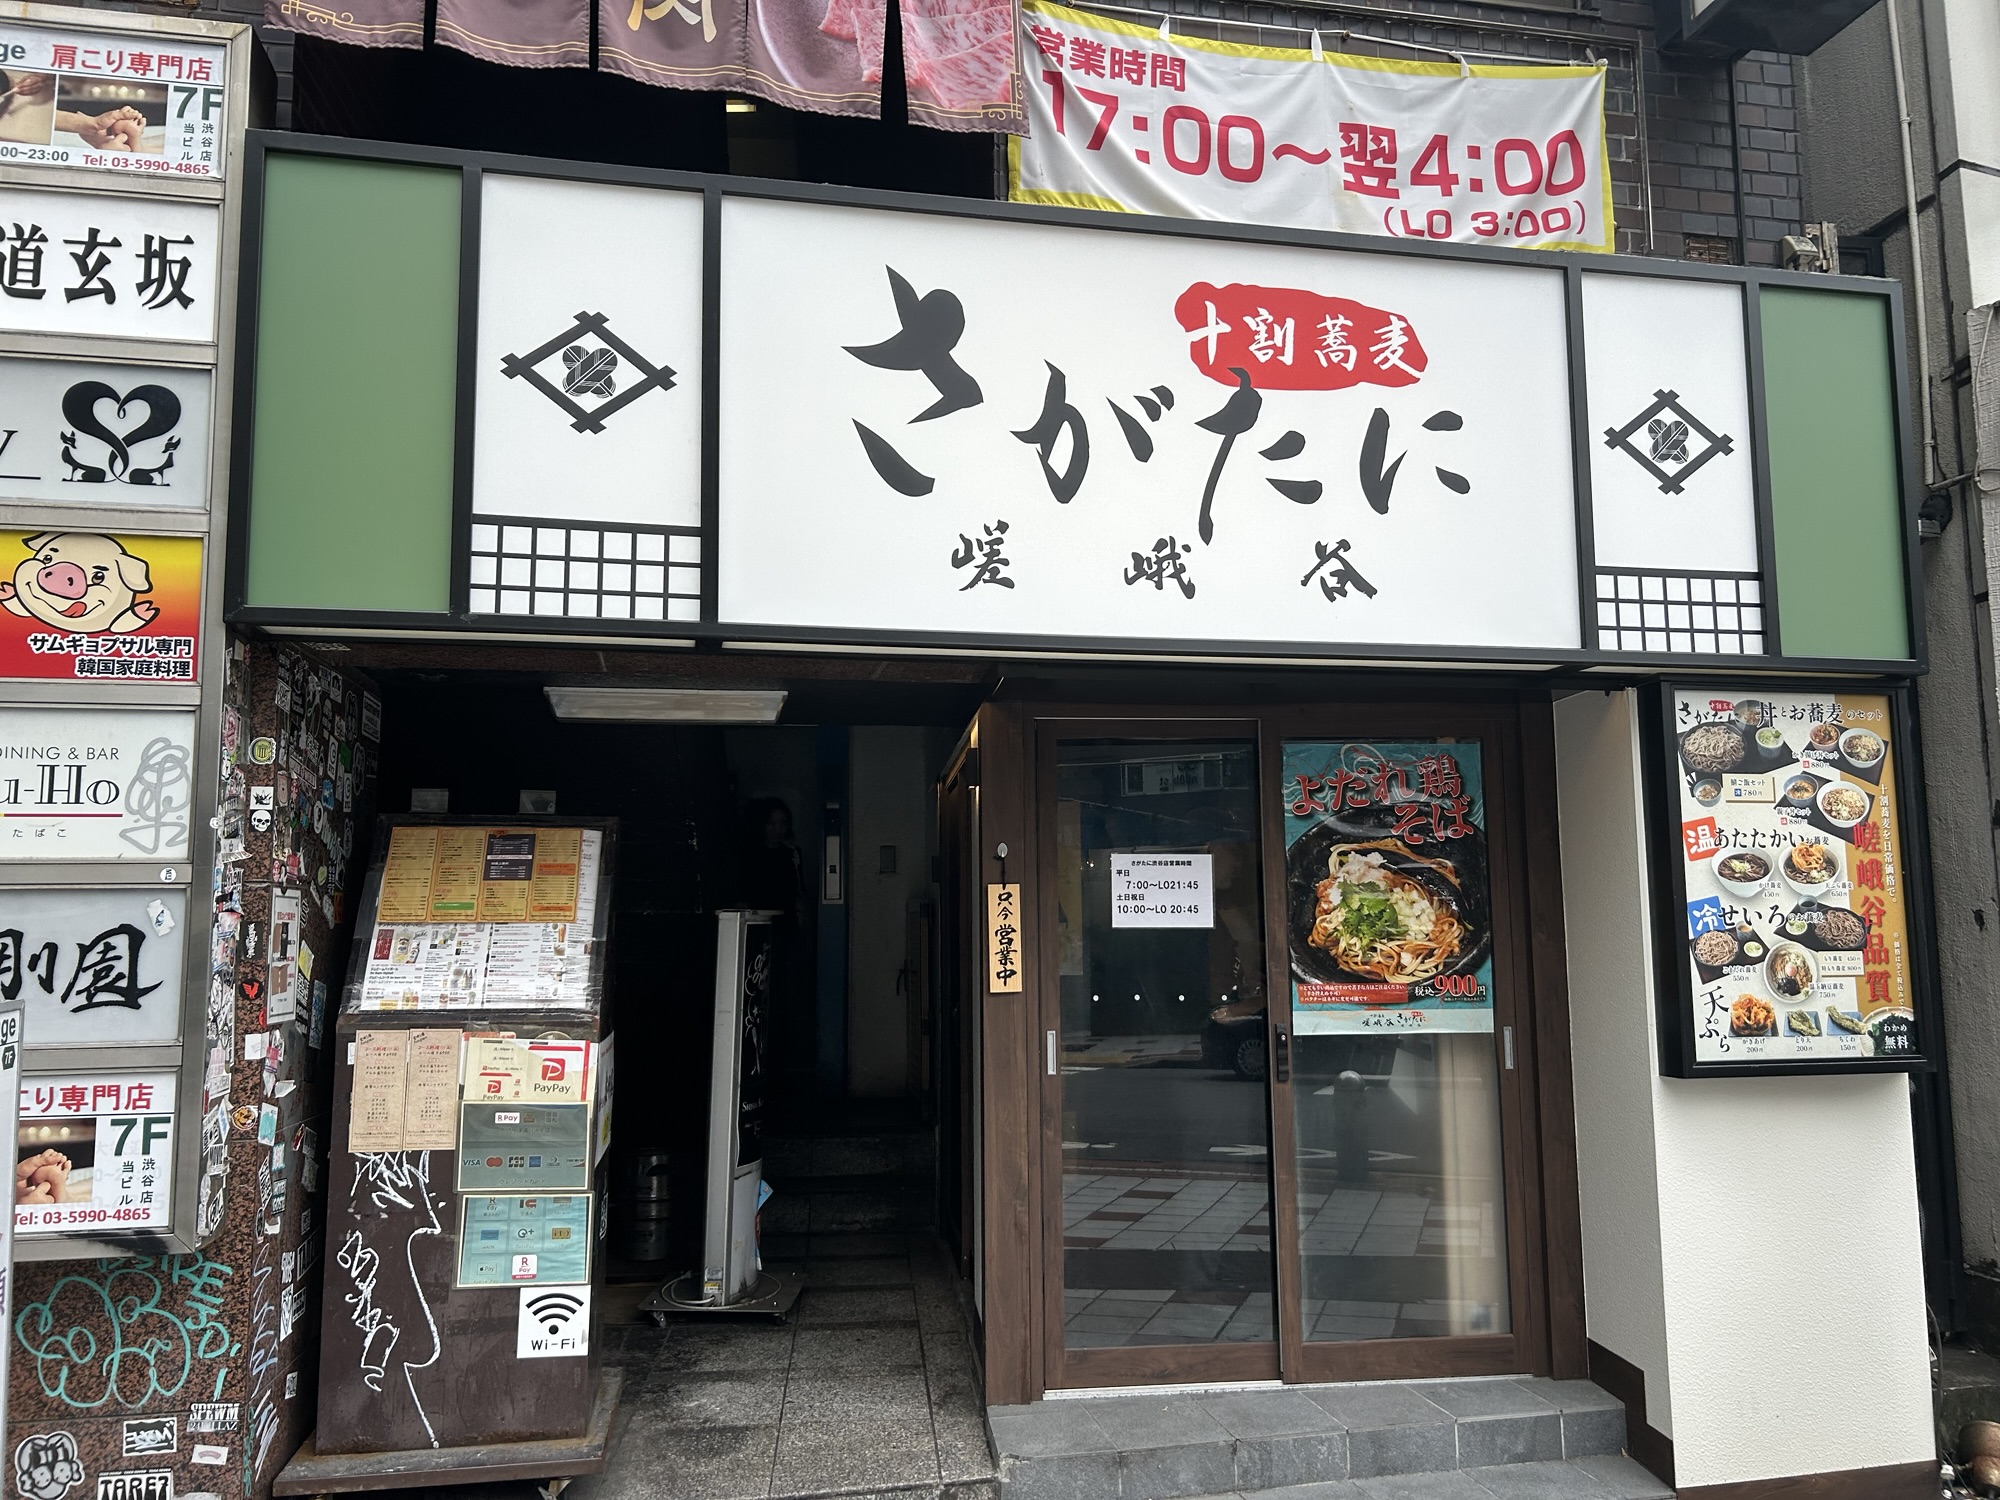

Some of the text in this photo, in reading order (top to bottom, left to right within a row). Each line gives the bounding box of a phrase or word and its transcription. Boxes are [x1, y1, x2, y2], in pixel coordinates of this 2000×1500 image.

[51, 44, 213, 81] 肩こり専門店
[1031, 23, 1187, 92] 営業時間
[173, 86, 223, 121] 7F
[182, 123, 195, 162] 当ビル
[200, 122, 214, 162] 渋谷店
[83, 154, 210, 175] Tel: 03-5990-4865
[0, 223, 195, 310] 道玄坂
[1190, 299, 1425, 383] 十割蕎麦
[840, 263, 1472, 546] さがたに
[950, 518, 1379, 602] 嵯峨谷
[28, 633, 193, 656] サムギョプサル専門
[76, 657, 192, 678] 韓国家庭料理
[1678, 701, 1739, 725] さがたに
[1756, 702, 1883, 728] 丼とお蕎麦のセット
[67, 747, 79, 760] &
[87, 747, 119, 760] BAR
[1811, 761, 1830, 769] 880円
[1291, 754, 1462, 816] よだれ鶏
[12, 828, 67, 838] たばこ
[1392, 795, 1475, 844] そば
[1686, 824, 1830, 854] 温 あたたかいお蕎麦
[1879, 784, 1898, 903] 十割蕎麦を日常価格で。
[1116, 869, 1130, 877] 平日
[1116, 893, 1145, 901] 土日祝日
[1170, 904, 1199, 914] 20:45
[1692, 903, 1825, 932] 冷 せいろのお蕎麦
[1853, 822, 1893, 1003] 嵯峨谷品質
[994, 891, 1018, 987] 只今営業中
[1, 1016, 16, 1042] ge
[1699, 985, 1731, 1053] 天ぷら
[1883, 1024, 1908, 1032] わかめ
[1884, 1035, 1909, 1049] 無料
[4, 1051, 14, 1065] 7F
[534, 1083, 571, 1094] PayPay
[110, 1116, 171, 1157] 7F
[119, 1160, 134, 1206] 当ビル
[140, 1157, 156, 1204] 渋谷店
[42, 1207, 151, 1226] 03-5990-4865
[531, 1338, 576, 1350] Wi-Fi
